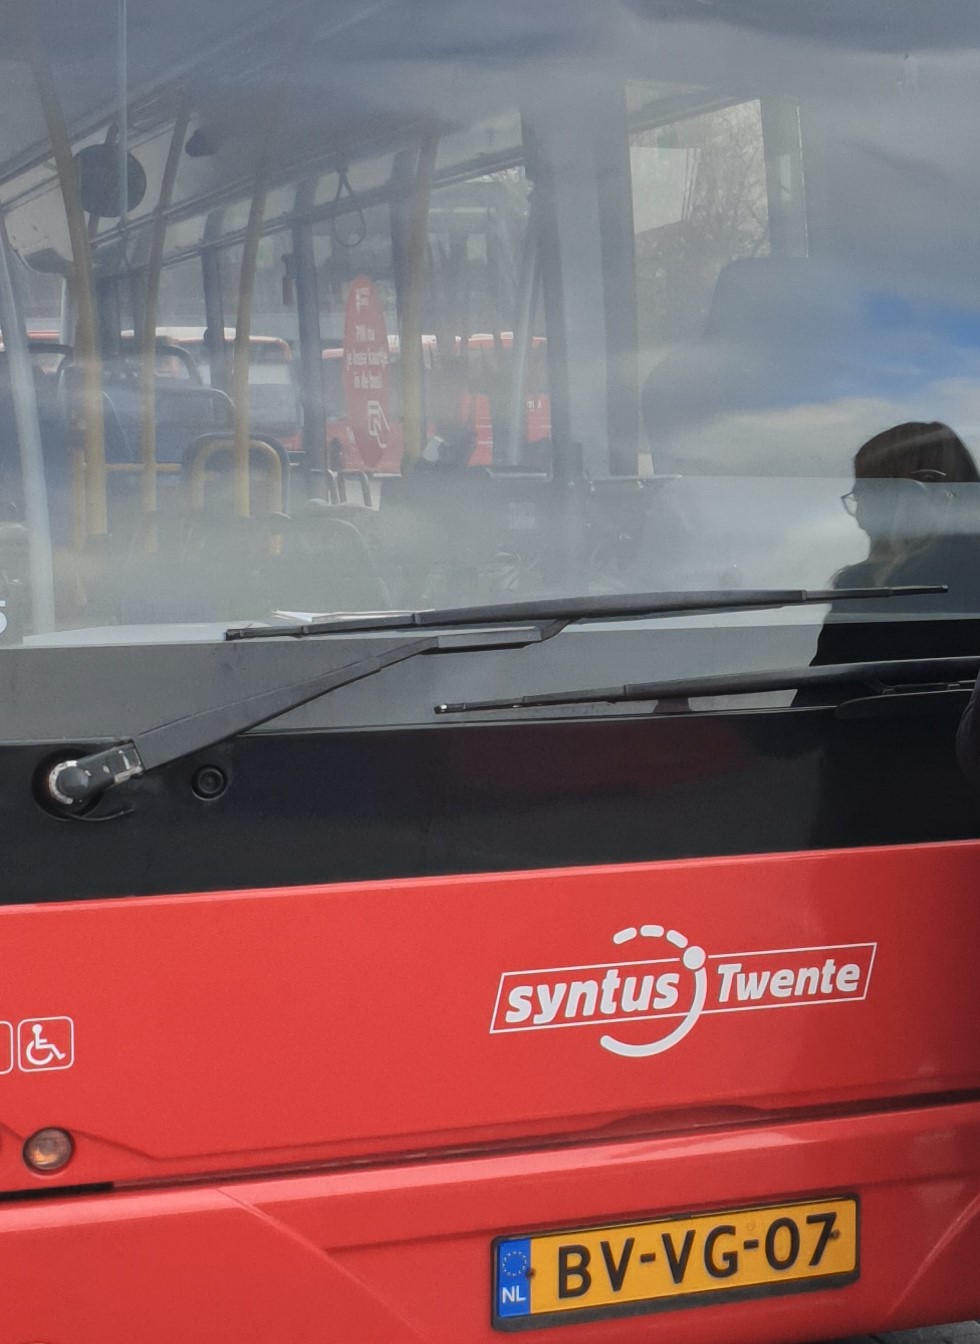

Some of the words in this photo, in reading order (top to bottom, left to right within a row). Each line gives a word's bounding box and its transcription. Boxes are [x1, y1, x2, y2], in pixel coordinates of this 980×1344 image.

[505, 968, 680, 1024] syntus
[717, 958, 861, 1003] Twente
[557, 1211, 838, 1300] BV-VG-07
[501, 1286, 527, 1304] NL
